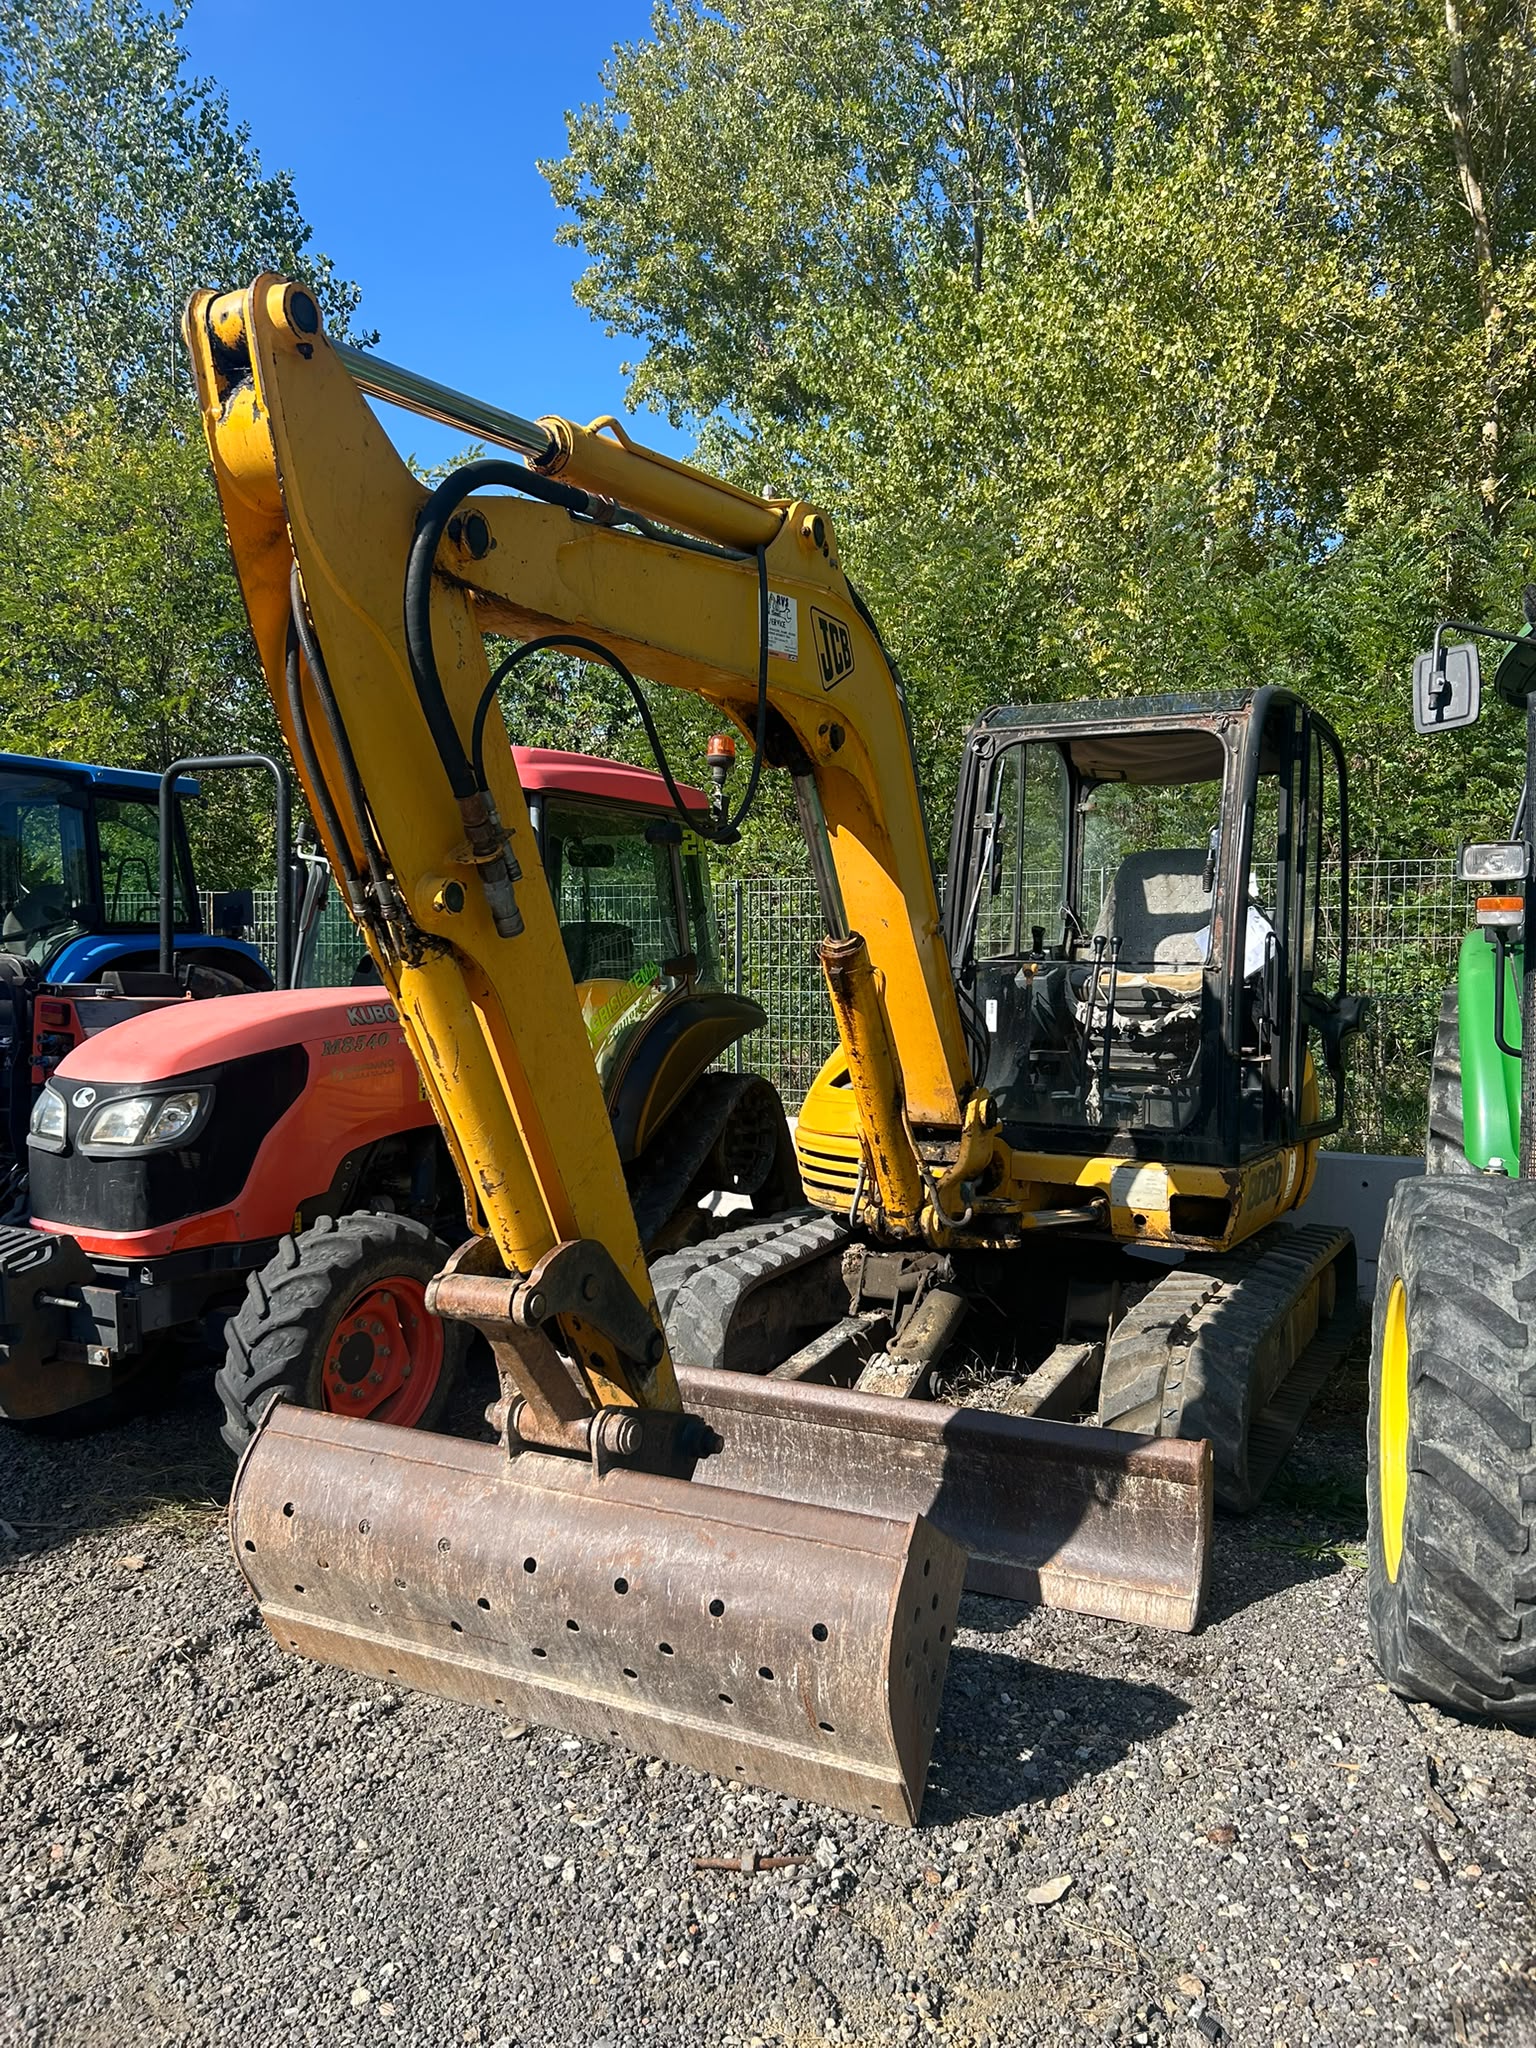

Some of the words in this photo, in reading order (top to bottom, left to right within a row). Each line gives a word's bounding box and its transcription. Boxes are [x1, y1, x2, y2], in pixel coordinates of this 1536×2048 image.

[818, 616, 852, 682] JCB
[587, 960, 660, 1040] GRISISTEMA
[321, 1031, 390, 1057] M8540
